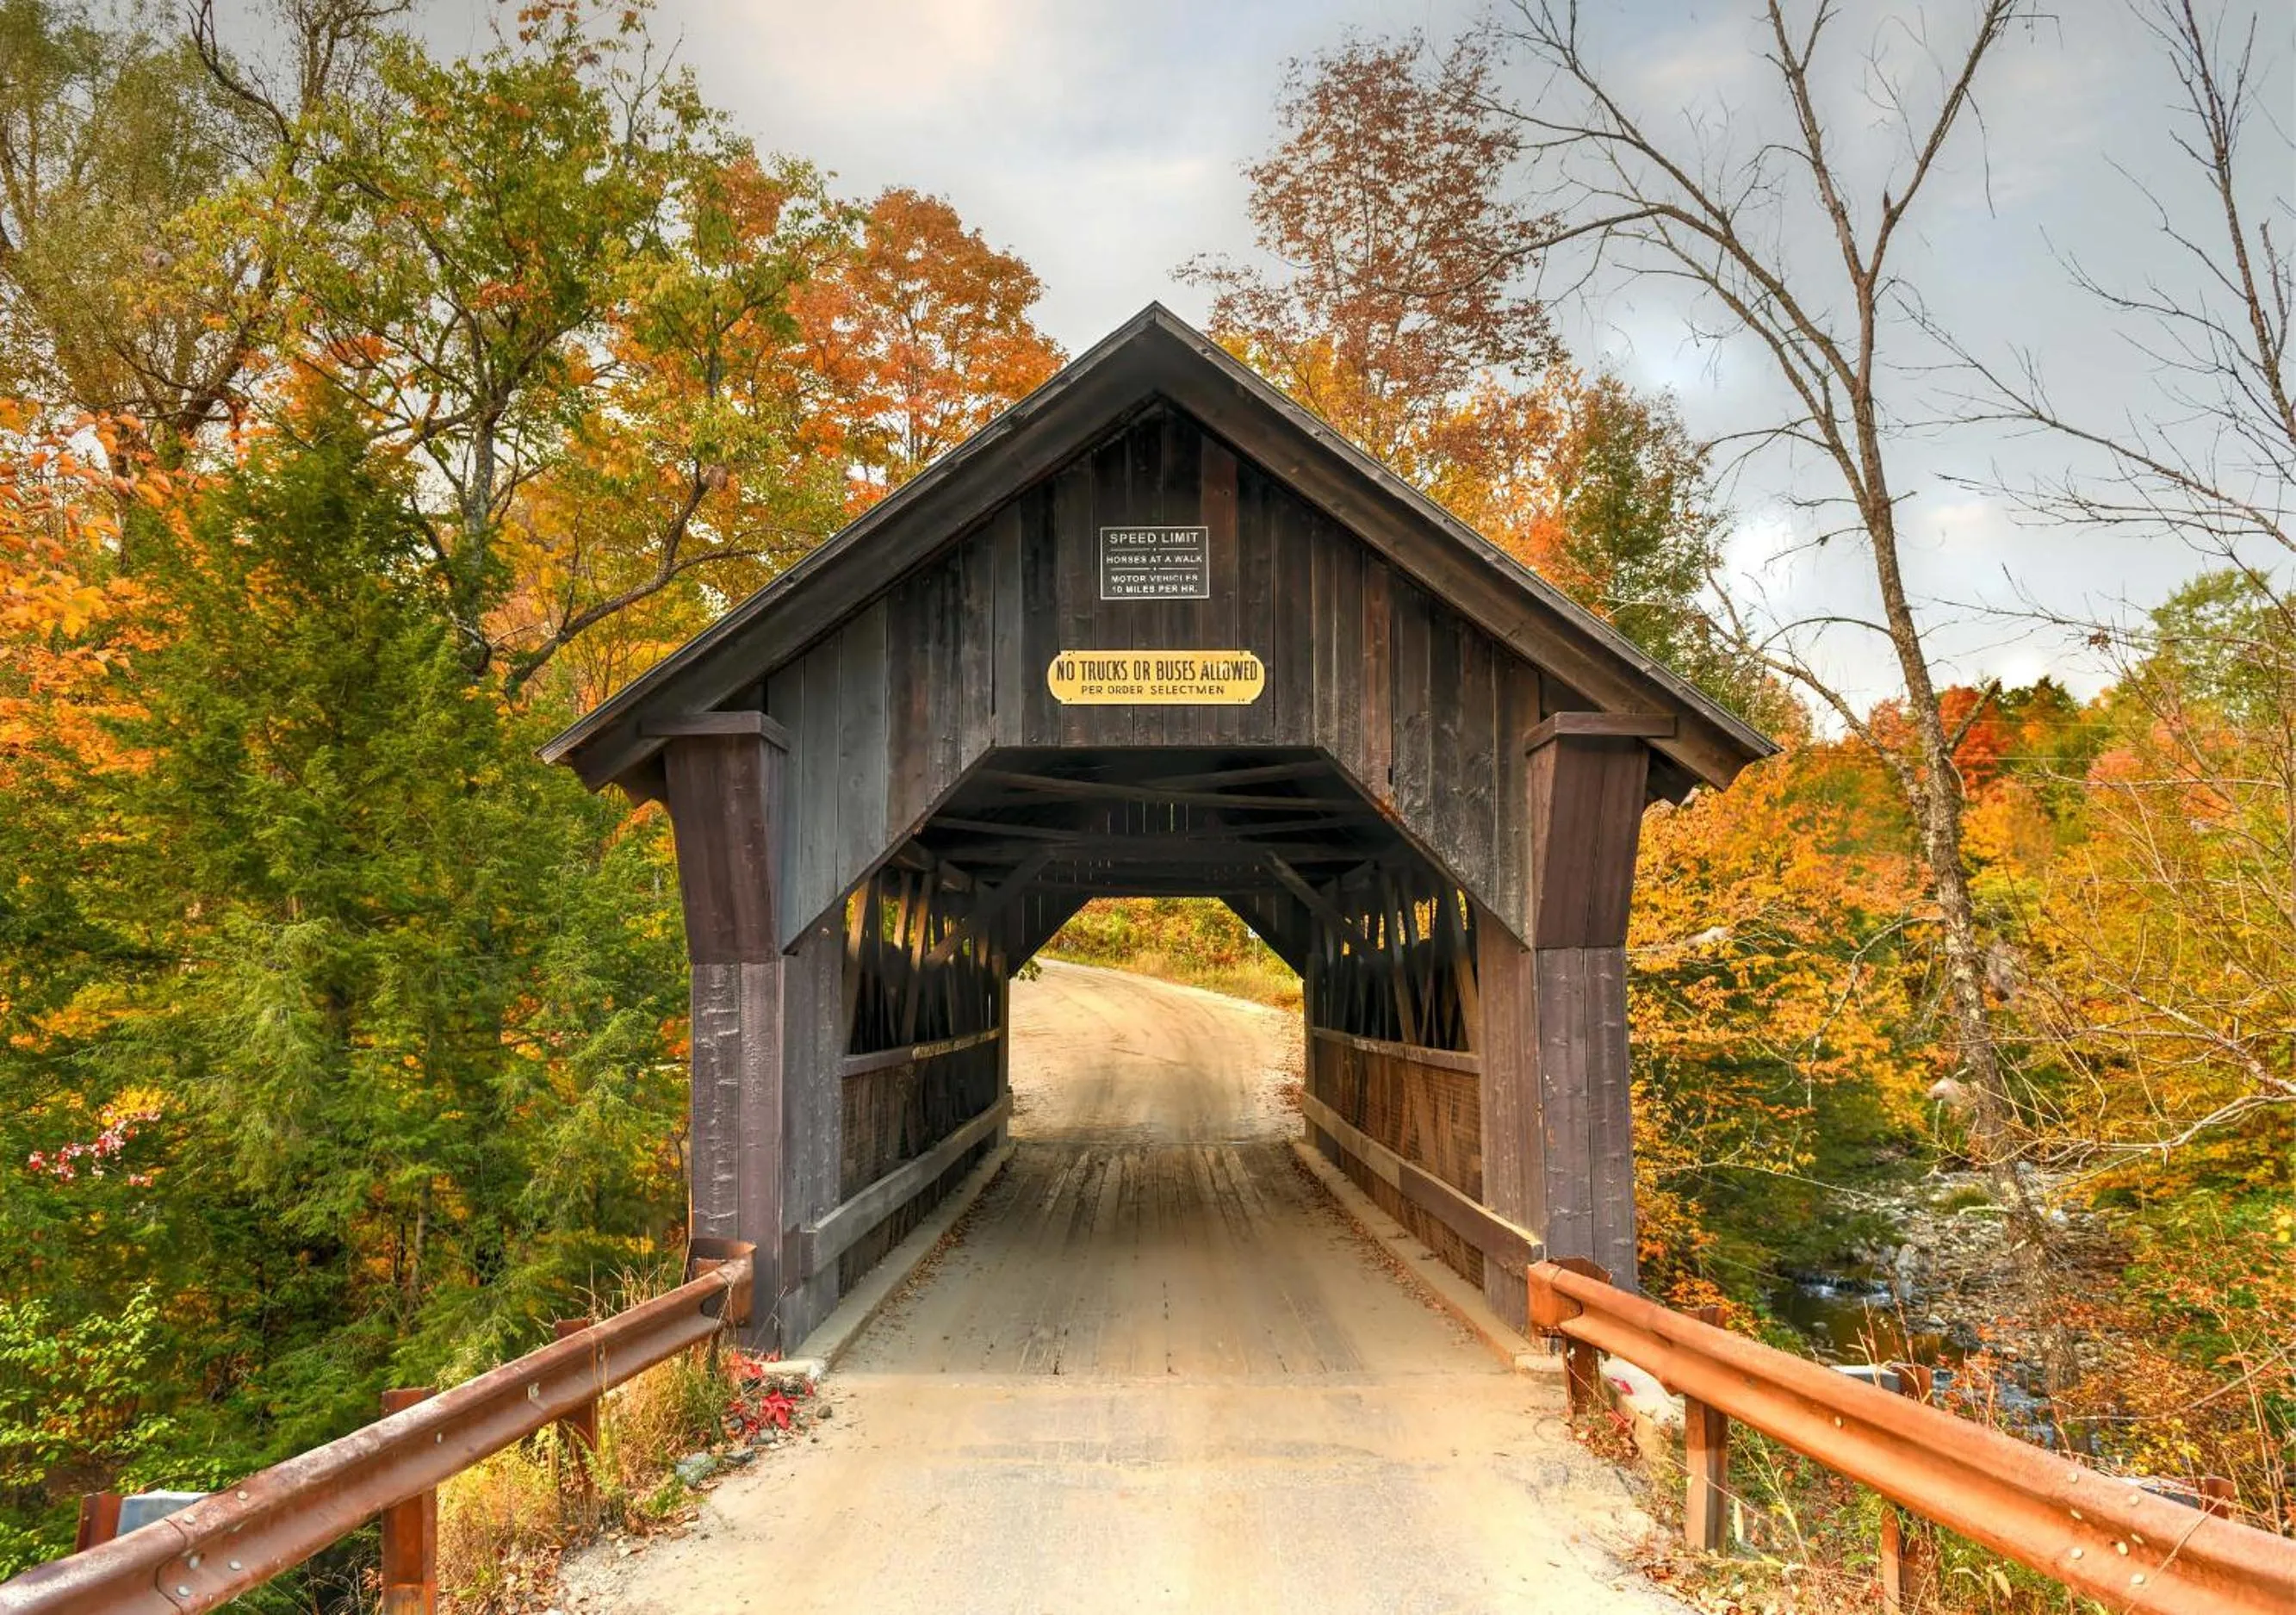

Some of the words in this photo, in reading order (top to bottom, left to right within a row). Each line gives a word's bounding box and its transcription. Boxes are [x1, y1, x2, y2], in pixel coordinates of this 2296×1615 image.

[1109, 532, 1156, 544] SPEED
[1162, 532, 1199, 543] LIMIT
[1057, 661, 1075, 680] NO
[1080, 661, 1127, 680] TRUCKS
[1134, 661, 1151, 680] OR
[1157, 661, 1195, 680] BUSES
[1201, 661, 1257, 681] ALLOWED
[1081, 686, 1102, 694] PER
[1108, 686, 1143, 694] ORDER
[1151, 686, 1224, 694] SELECTMEN
